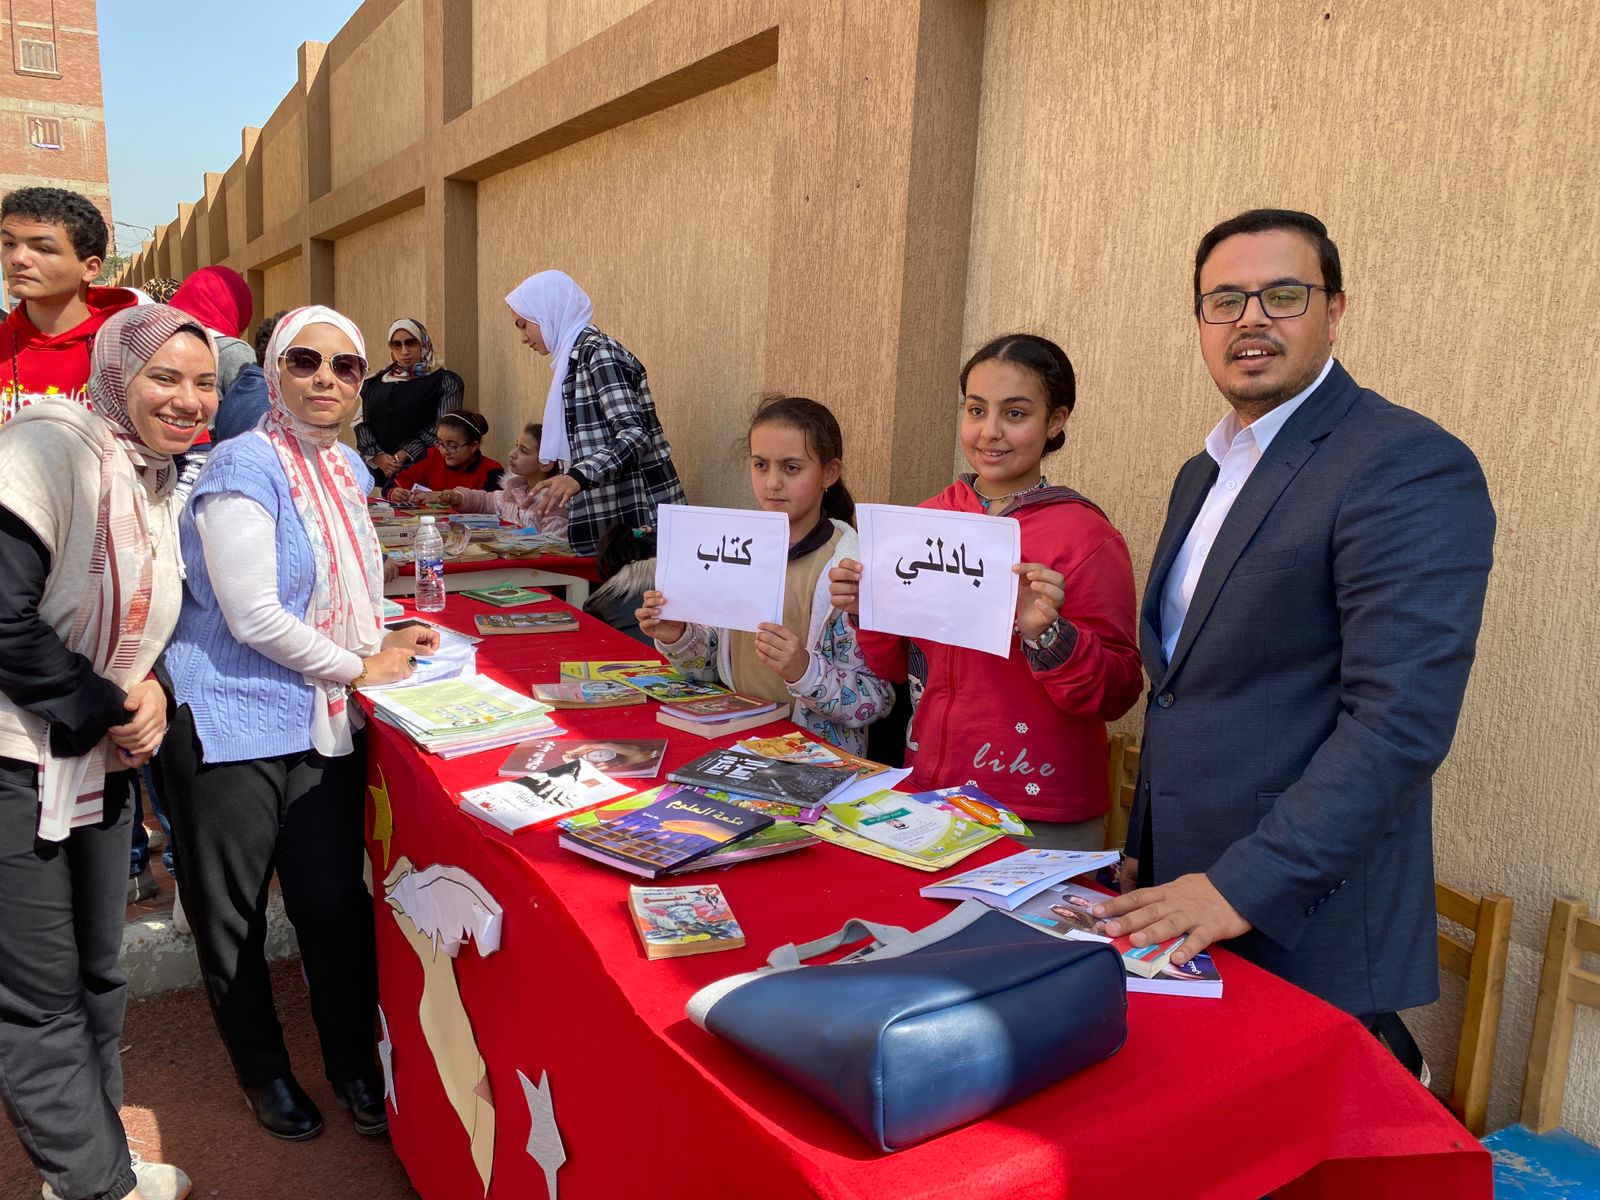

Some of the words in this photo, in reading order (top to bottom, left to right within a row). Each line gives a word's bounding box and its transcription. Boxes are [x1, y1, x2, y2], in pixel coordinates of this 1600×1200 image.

[697, 535, 752, 571] كتاب
[895, 537, 984, 588] بادلني
[973, 742, 1056, 777] like
[664, 800, 717, 816] العلوم
